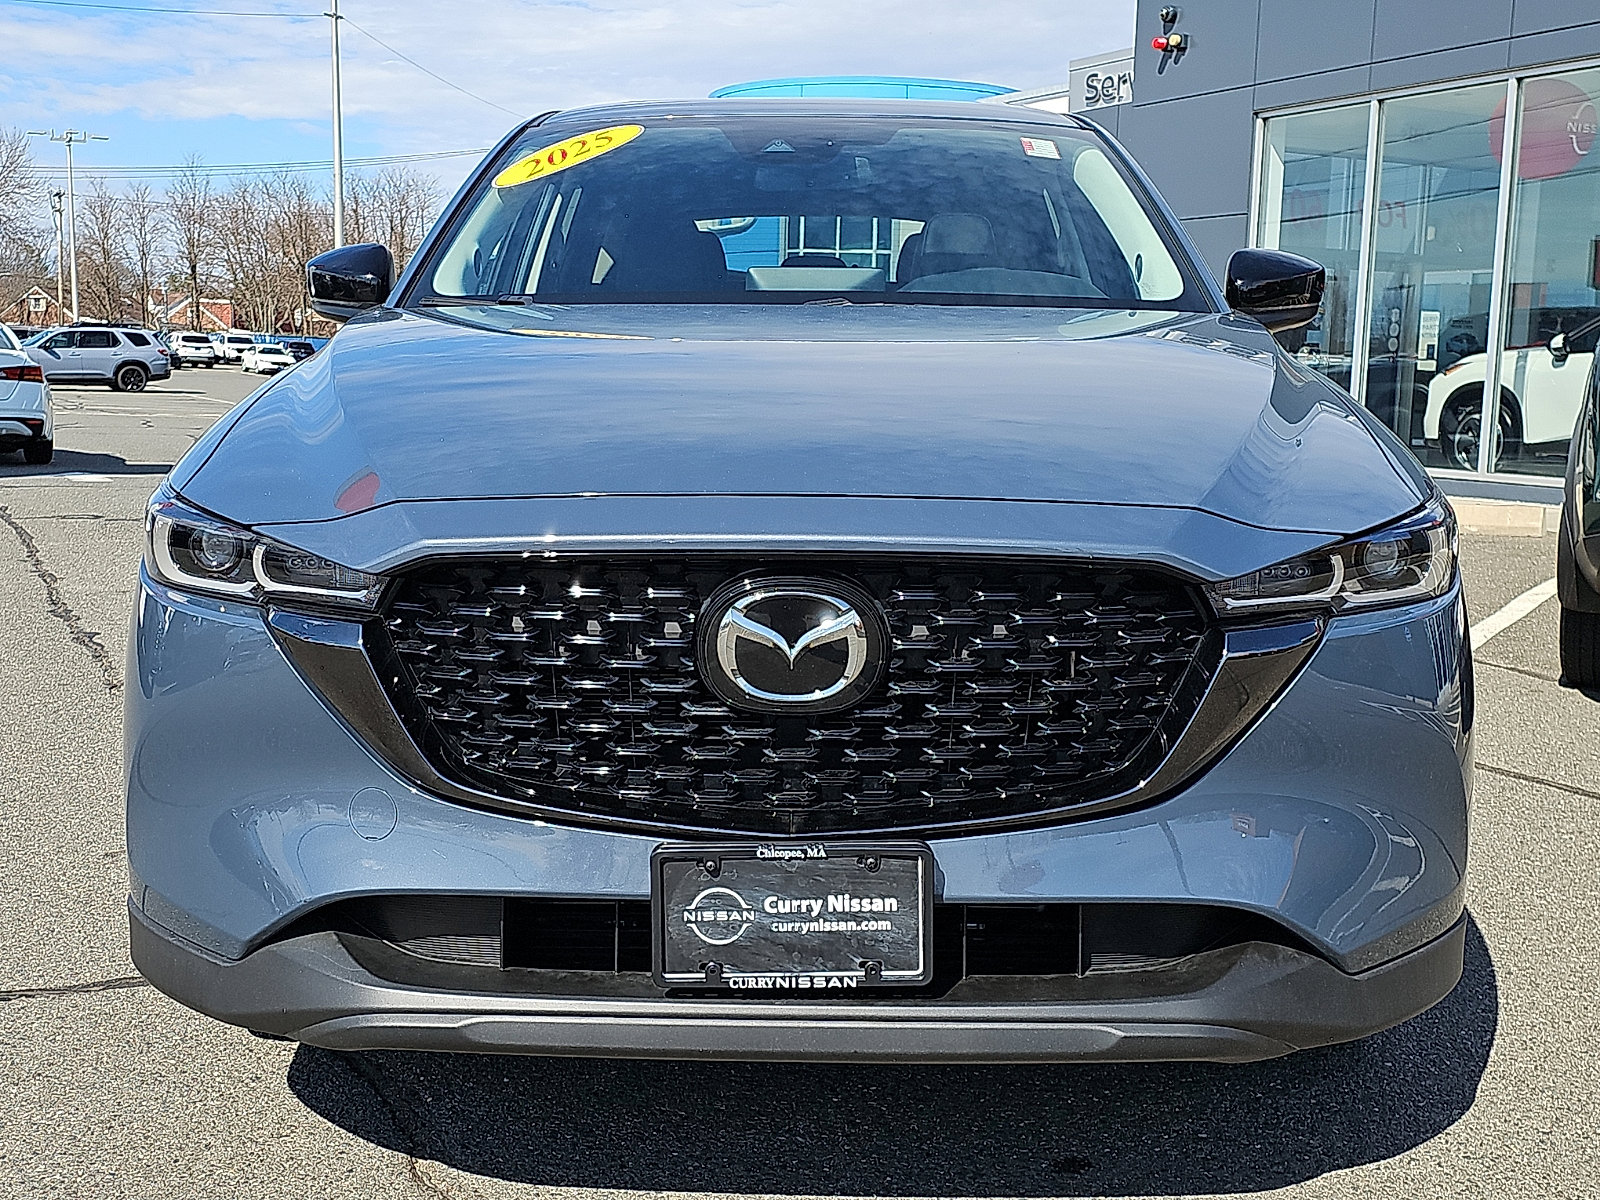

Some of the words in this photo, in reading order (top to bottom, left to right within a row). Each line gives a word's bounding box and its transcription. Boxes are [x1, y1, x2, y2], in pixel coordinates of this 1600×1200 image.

[522, 130, 613, 179] 2025
[756, 846, 805, 860] Chicopee,
[806, 846, 827, 858] MA
[764, 895, 824, 917] Curry
[827, 894, 898, 913] Nissan
[683, 911, 755, 922] NISSAN
[771, 918, 892, 935] currynissan.com
